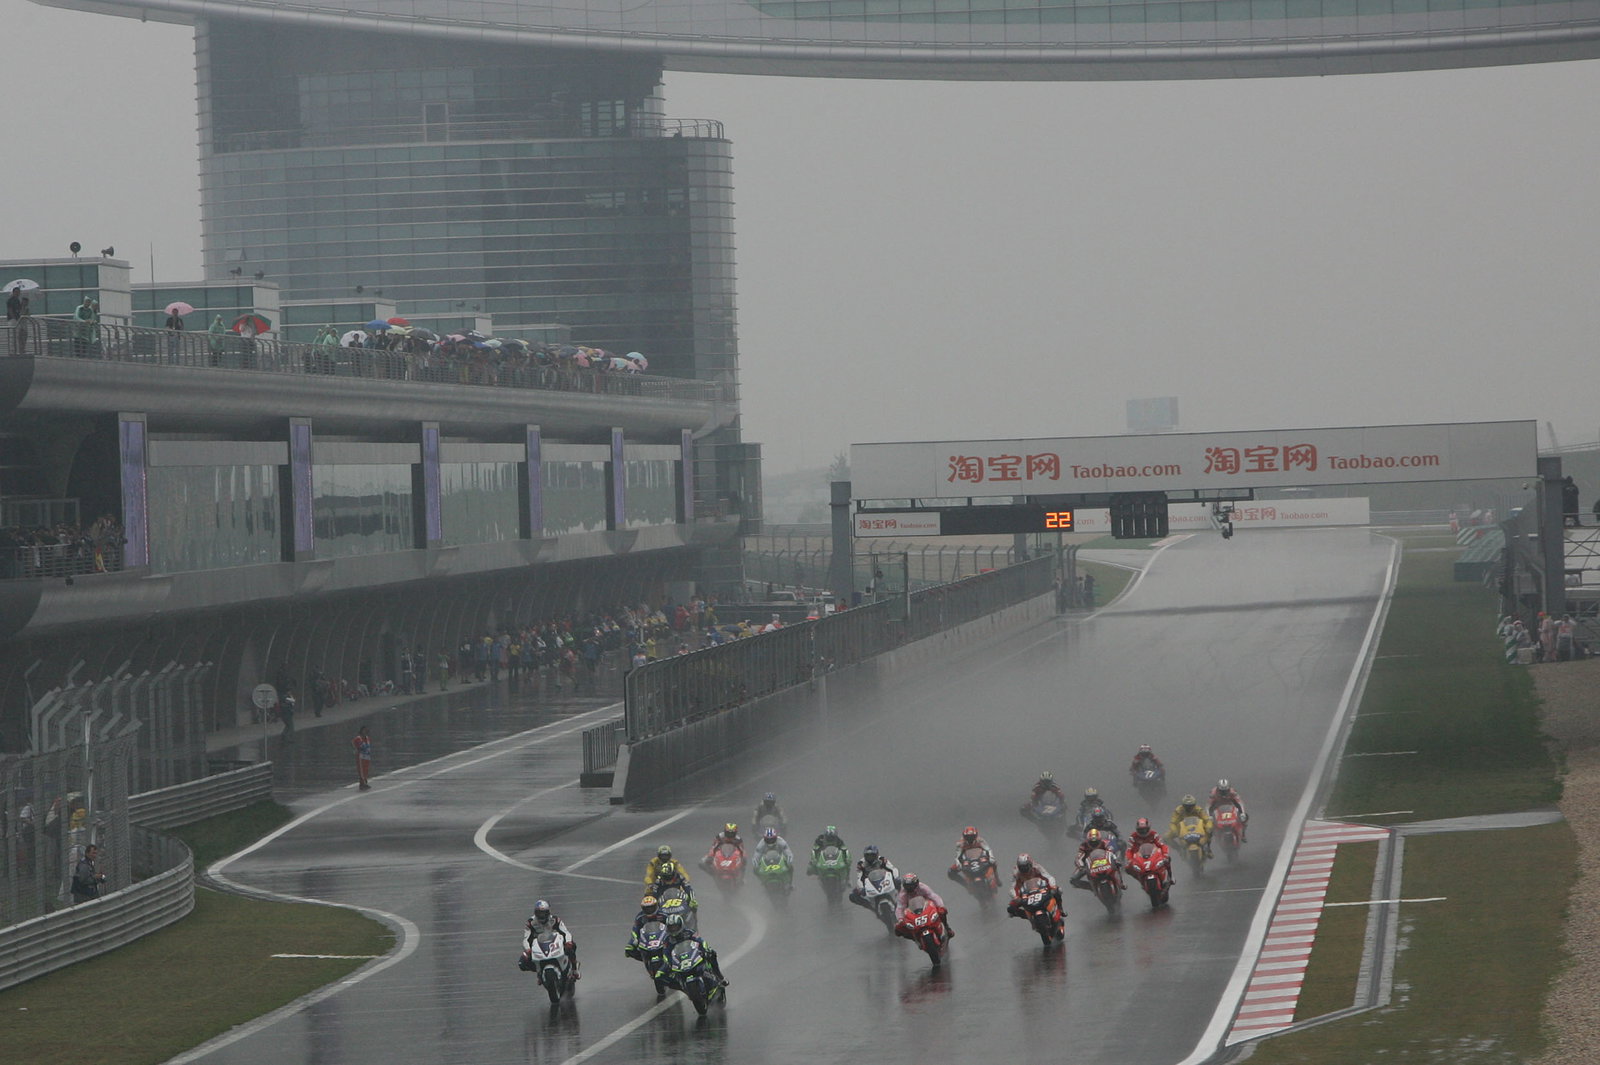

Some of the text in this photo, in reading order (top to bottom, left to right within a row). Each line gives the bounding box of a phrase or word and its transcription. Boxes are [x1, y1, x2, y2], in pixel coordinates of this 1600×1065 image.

[1203, 443, 1440, 475] 淘宝网 Taobao.com
[948, 452, 1182, 483] 淘宝网 Taobao.com
[1046, 511, 1071, 528] 22
[1280, 512, 1329, 520] Taobao.com
[859, 519, 897, 529] 淘宝网
[1027, 893, 1042, 905] 69
[914, 915, 928, 926] 65
